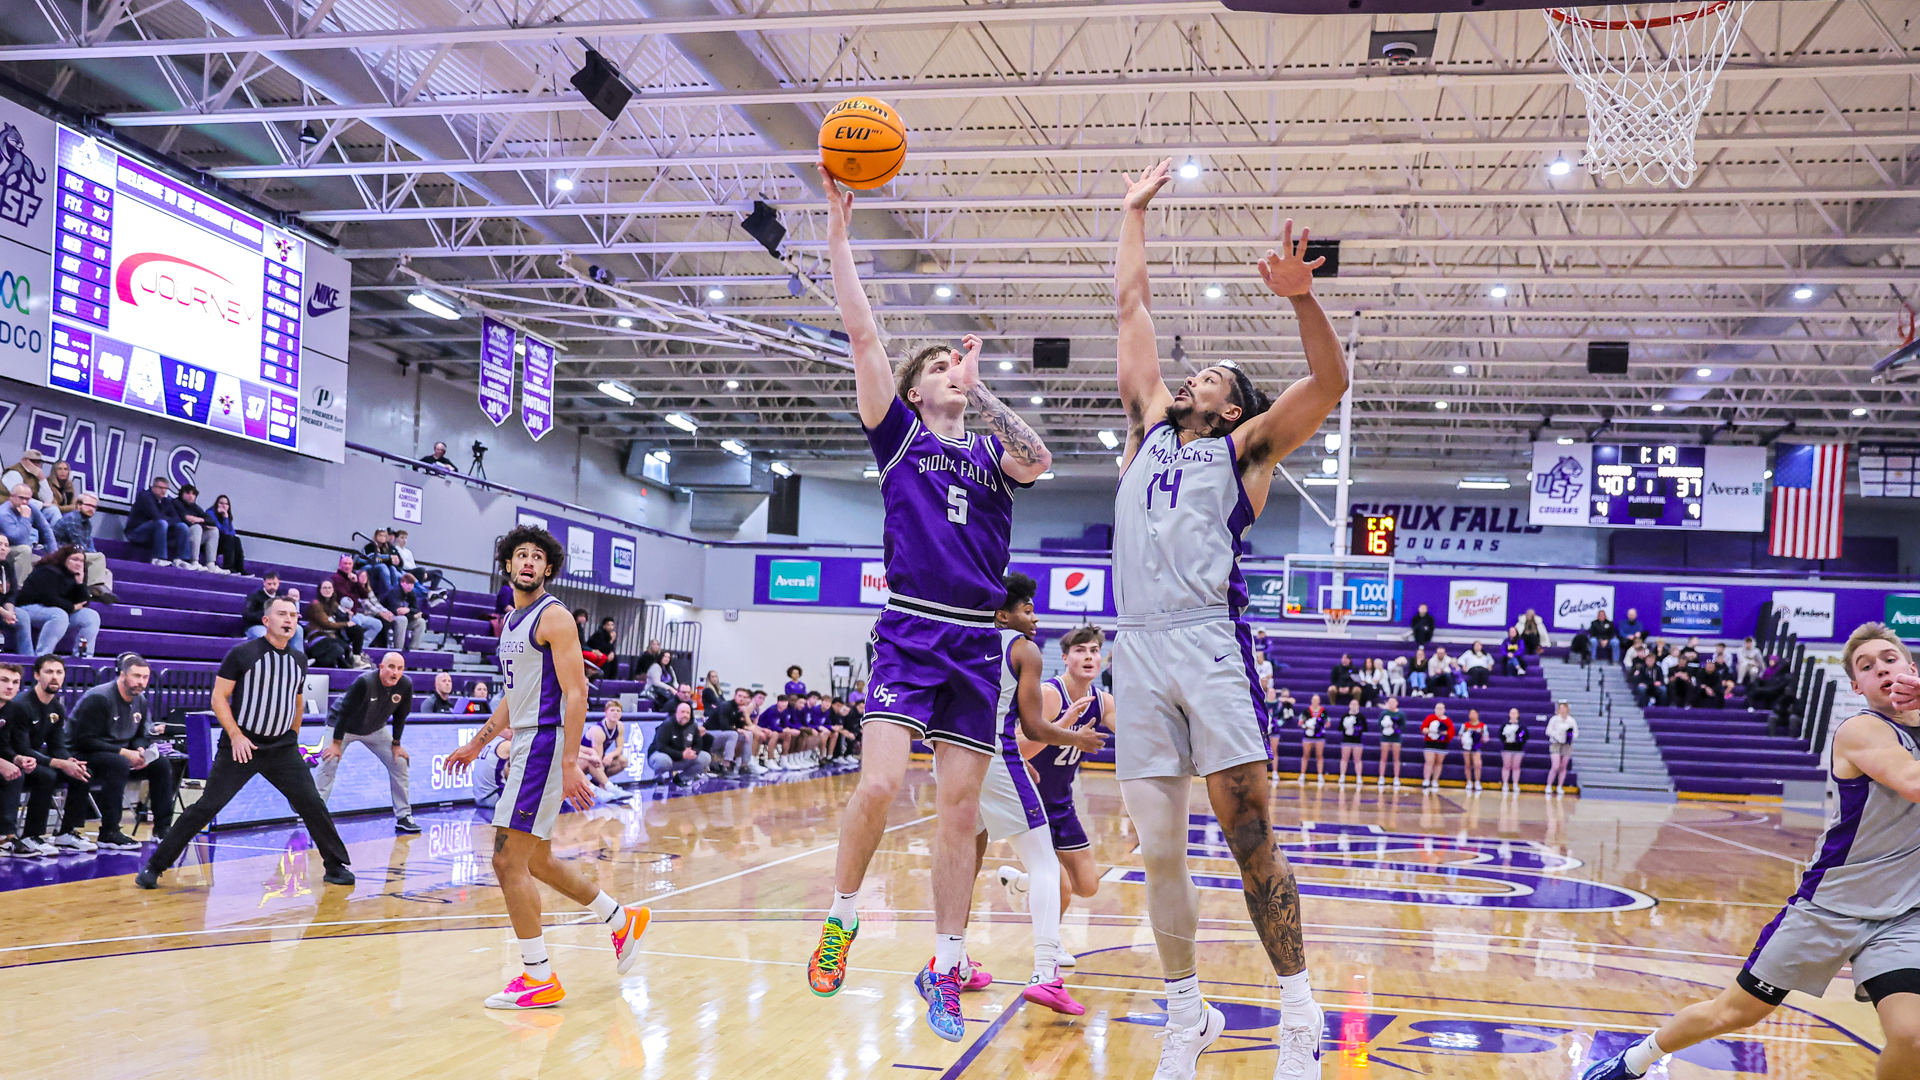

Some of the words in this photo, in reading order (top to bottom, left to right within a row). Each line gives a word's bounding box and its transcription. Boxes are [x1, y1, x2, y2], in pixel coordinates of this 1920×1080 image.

[832, 100, 889, 121] Wilson
[0, 178, 43, 228] SF
[313, 282, 340, 308] NIKE
[175, 364, 206, 392] 1:19
[481, 385, 509, 405] BASKETBALL
[523, 392, 550, 415] FOOTBALL
[26, 405, 201, 505] FALLS
[1641, 446, 1676, 465] 1:19
[918, 454, 957, 474] SIOUX
[960, 460, 998, 492] FALLS
[1147, 468, 1183, 510] 14
[1535, 473, 1583, 504] USF
[1598, 476, 1624, 496] 40
[1676, 477, 1702, 497] 37
[1707, 482, 1749, 496] Avera
[947, 484, 969, 526] 5
[1596, 502, 1608, 516] 4
[1367, 531, 1387, 553] 16
[1394, 535, 1500, 552] OUGARS
[775, 575, 805, 587] Avera
[1559, 597, 1607, 617] Culver's
[1665, 598, 1719, 613] SPECIALISTS
[873, 682, 898, 708] USF
[1053, 744, 1082, 766] 20
